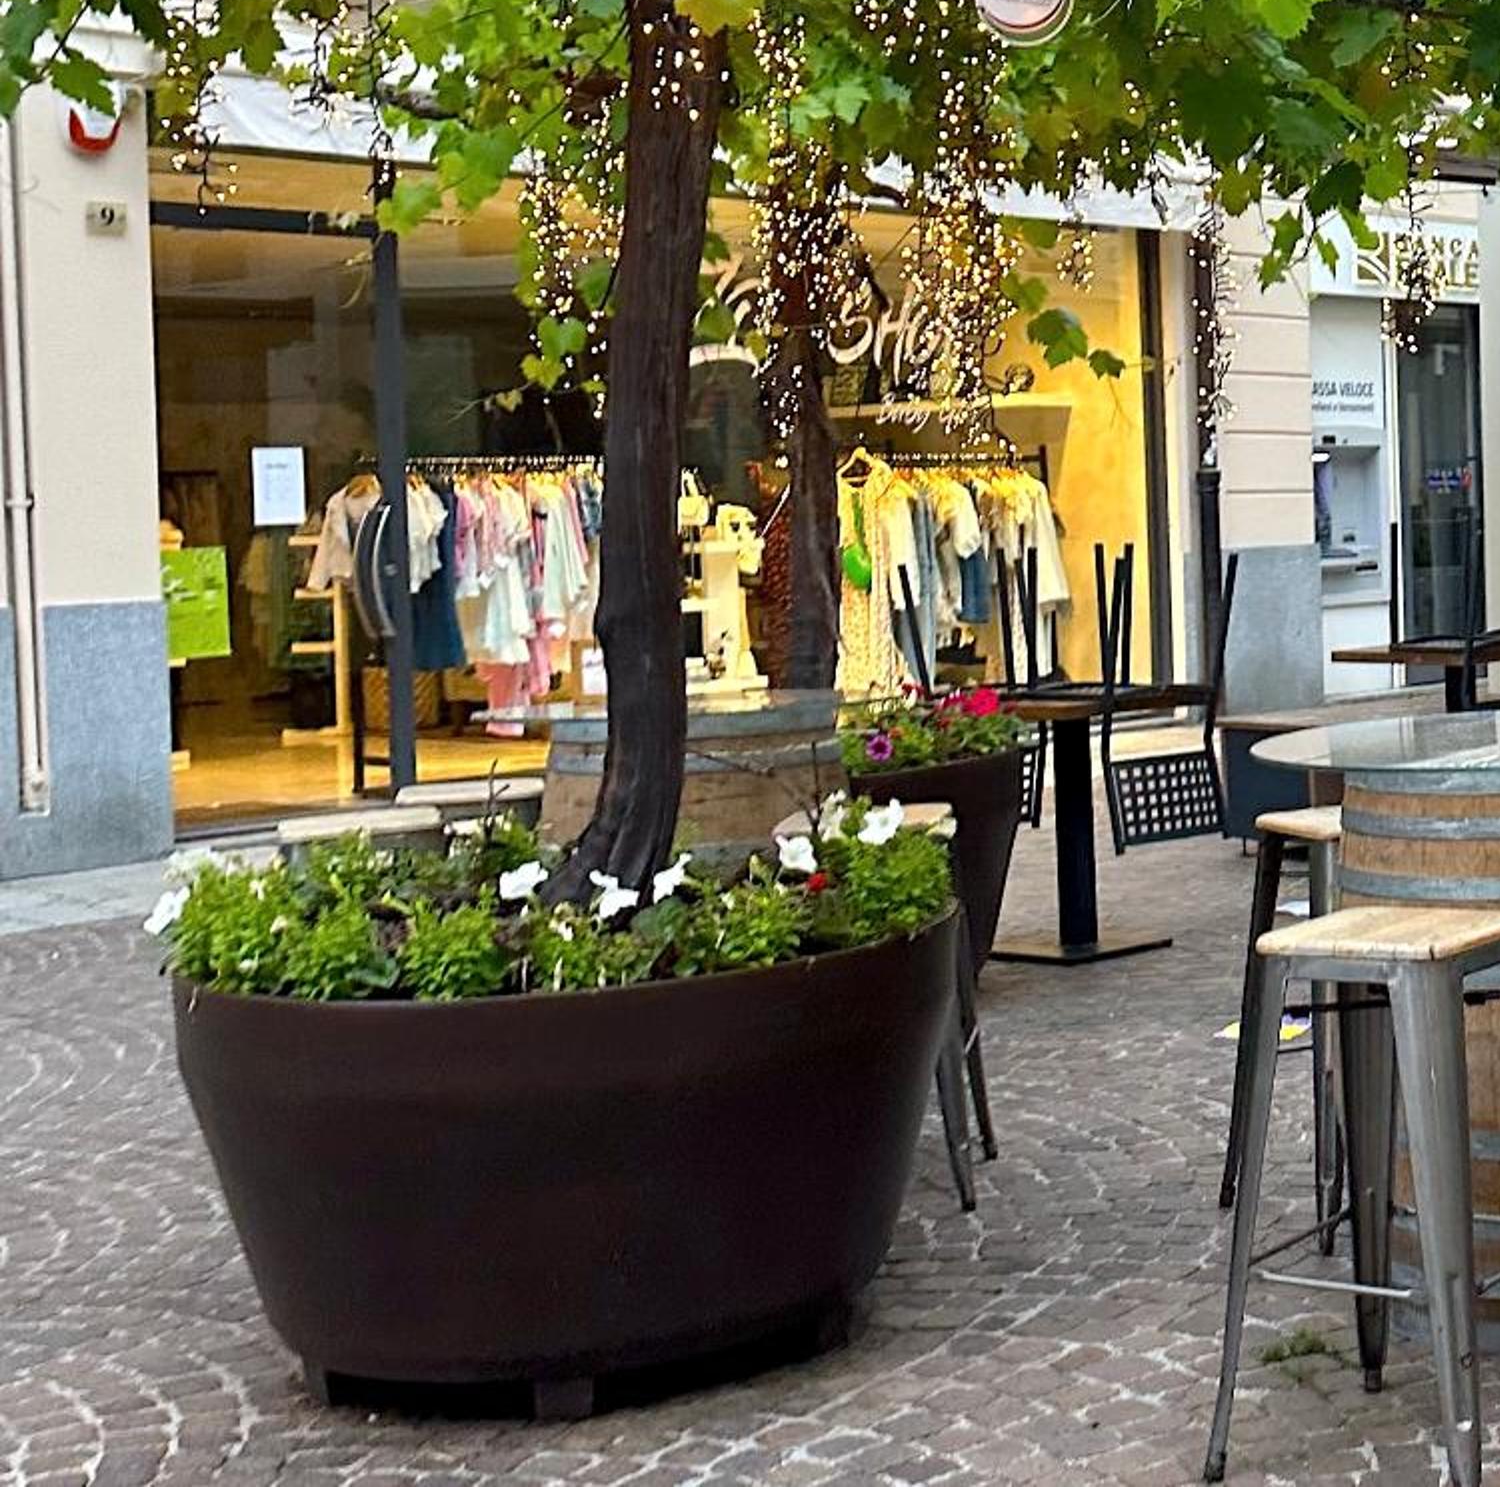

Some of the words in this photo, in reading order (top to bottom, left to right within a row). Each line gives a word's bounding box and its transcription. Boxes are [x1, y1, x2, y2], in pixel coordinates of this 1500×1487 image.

[100, 207, 115, 226] 9
[1312, 382, 1337, 396] ASSA
[1339, 382, 1374, 397] VELOCE
